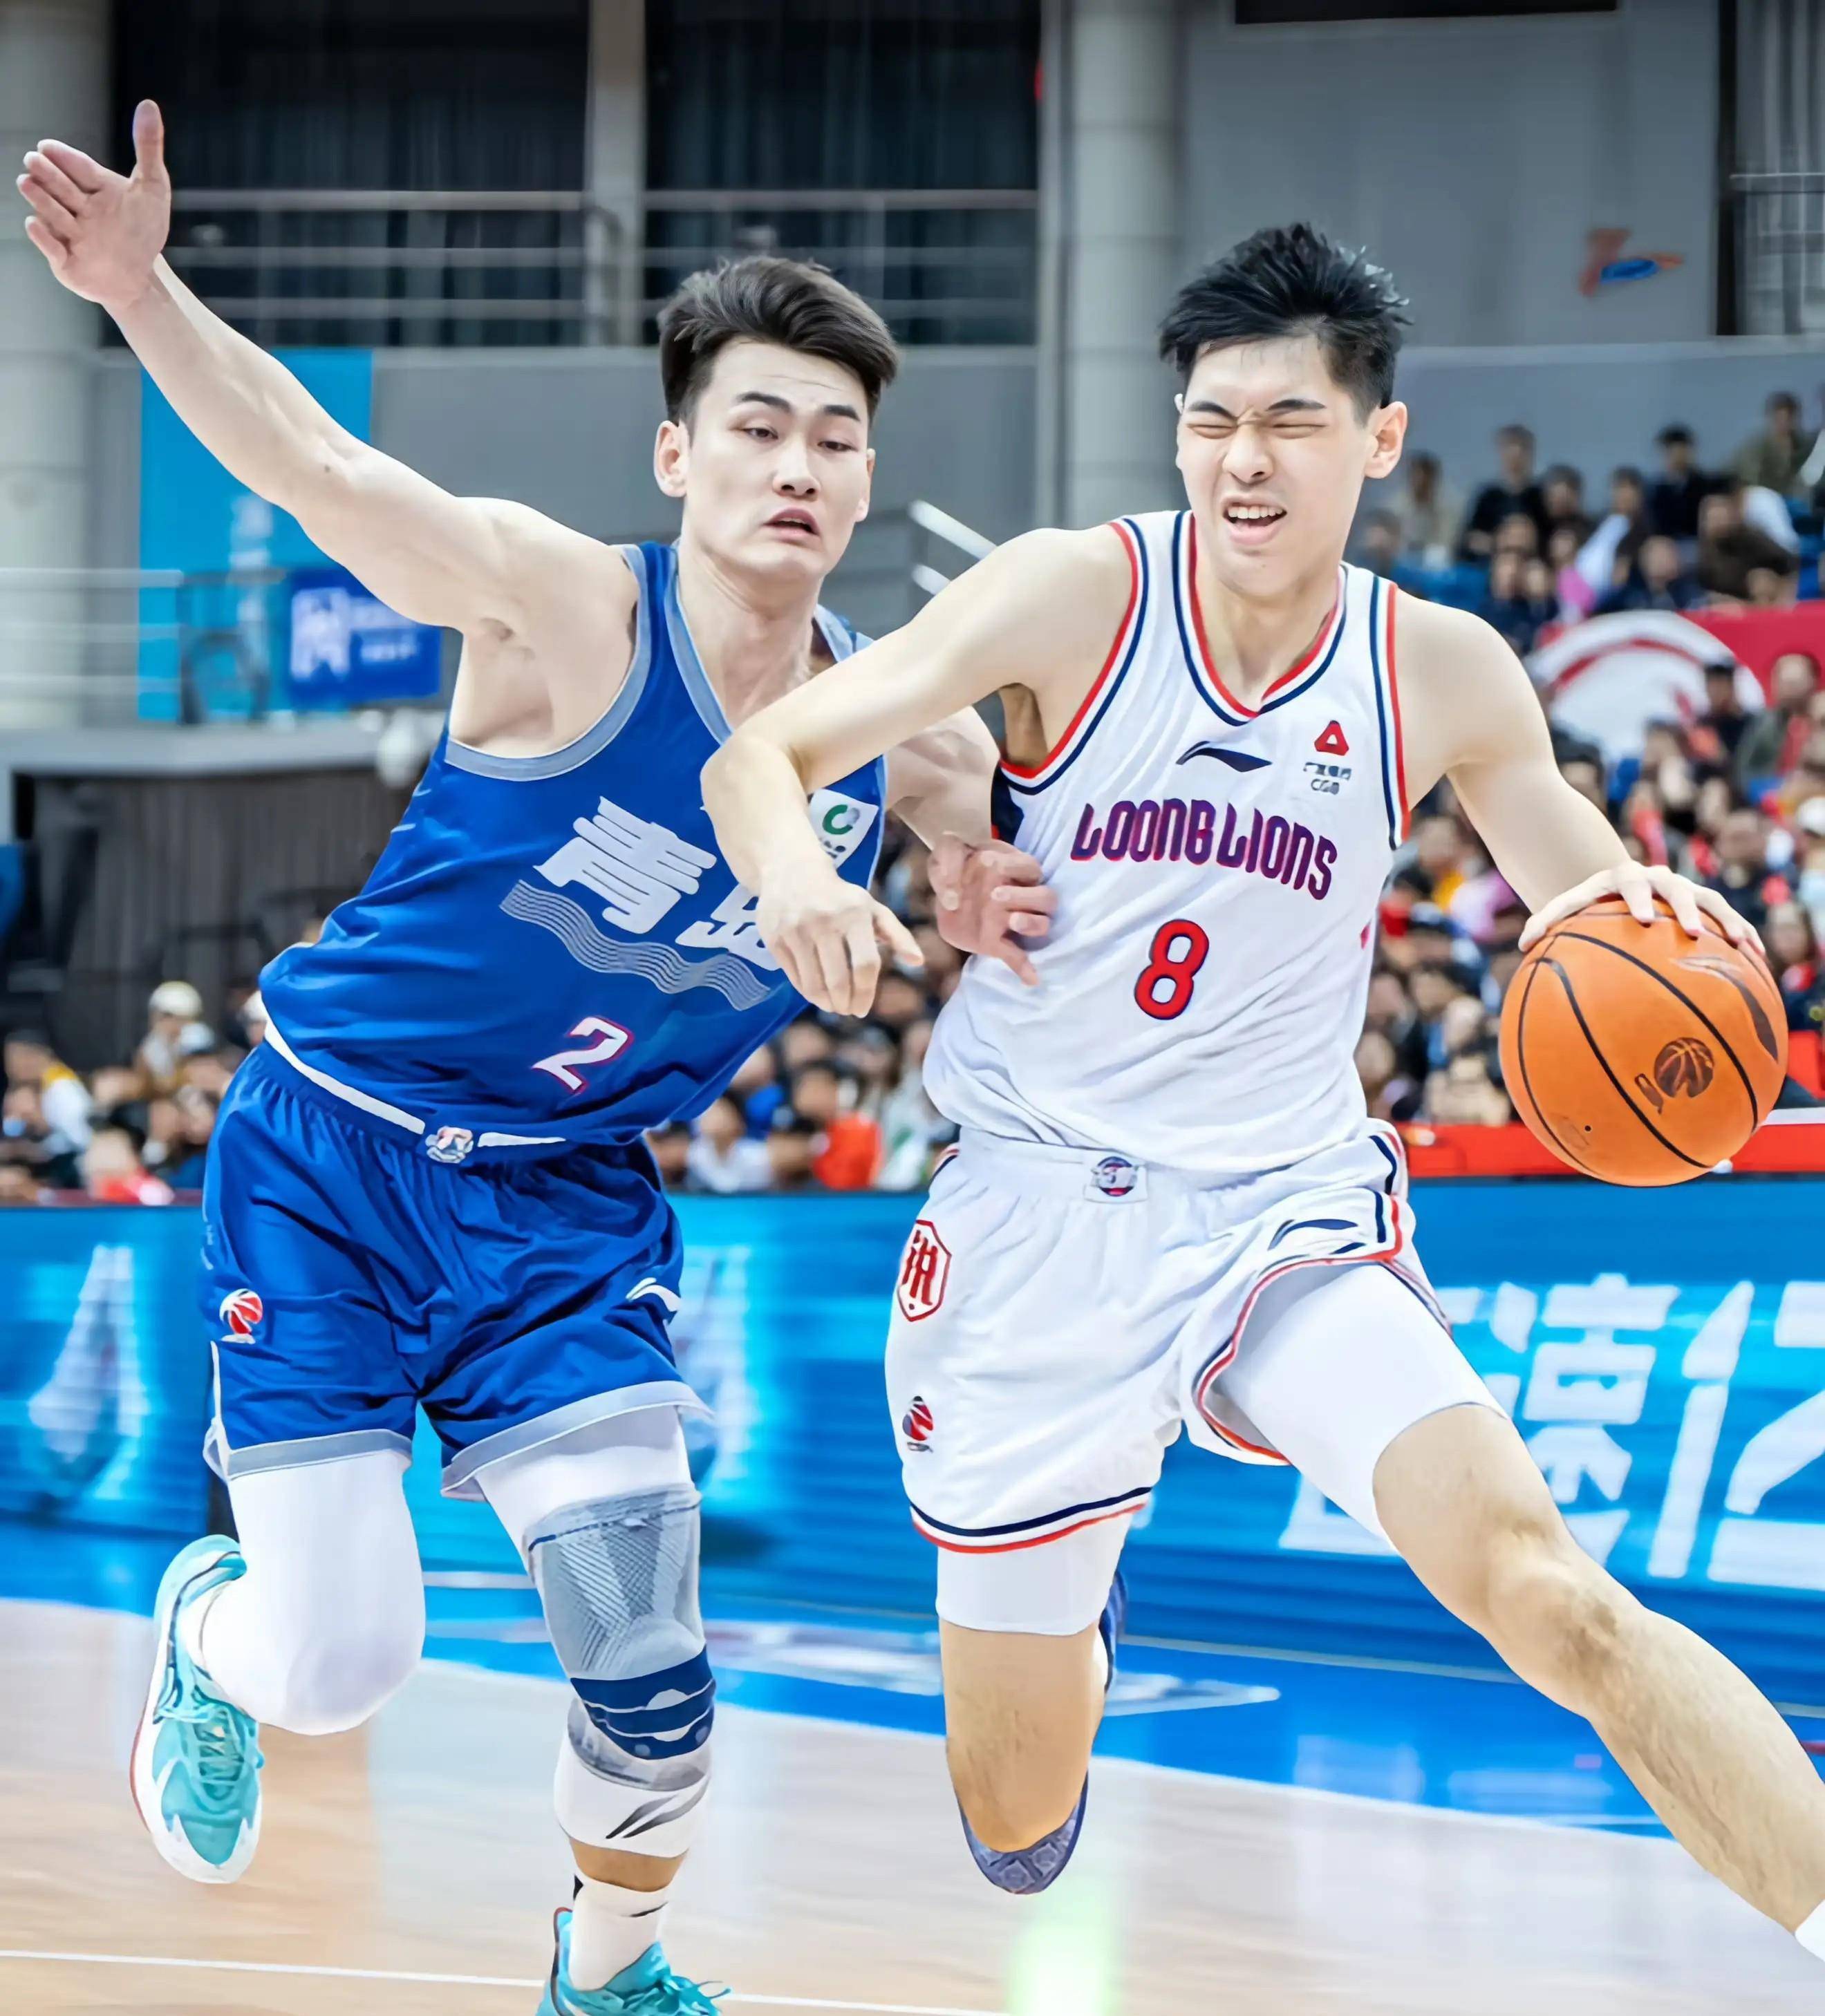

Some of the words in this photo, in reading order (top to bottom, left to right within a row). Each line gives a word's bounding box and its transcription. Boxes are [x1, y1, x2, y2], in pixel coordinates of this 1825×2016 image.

[1216, 802, 1338, 901] LIONS
[1134, 919, 1210, 1021] 8
[531, 1015, 635, 1095] 2
